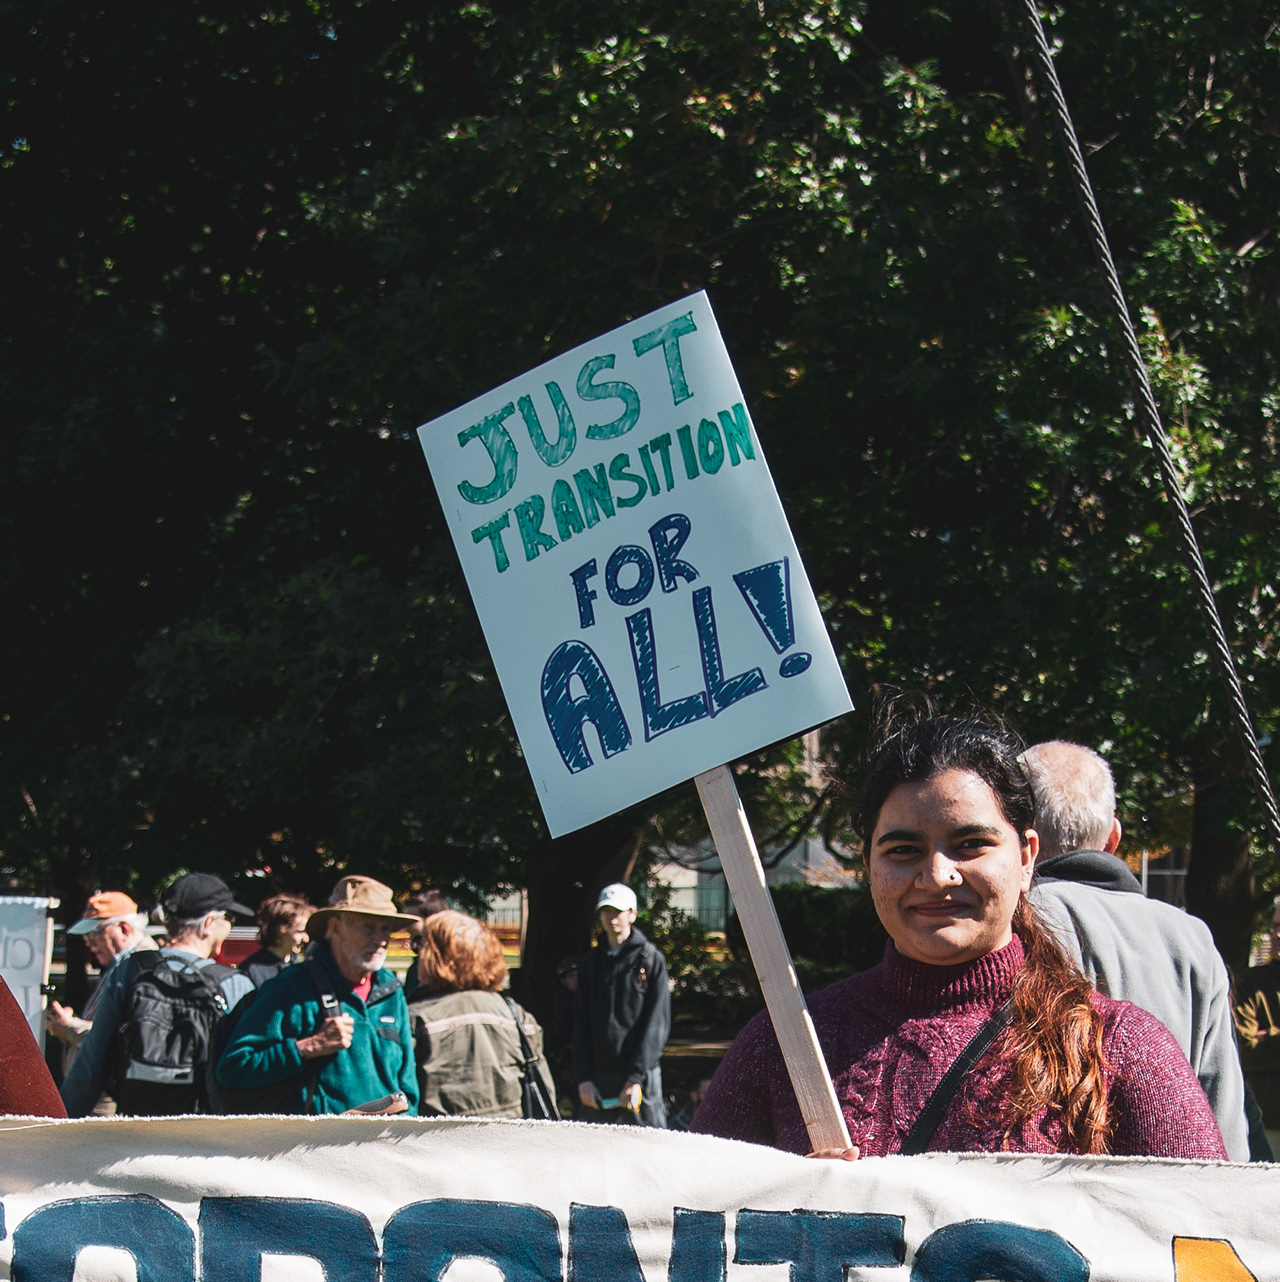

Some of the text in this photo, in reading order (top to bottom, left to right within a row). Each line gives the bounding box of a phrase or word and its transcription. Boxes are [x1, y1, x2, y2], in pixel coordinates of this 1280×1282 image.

[456, 310, 697, 505] JUST
[471, 403, 757, 573] TRANSITION
[569, 513, 700, 629] FOR
[540, 556, 812, 775] ALL!
